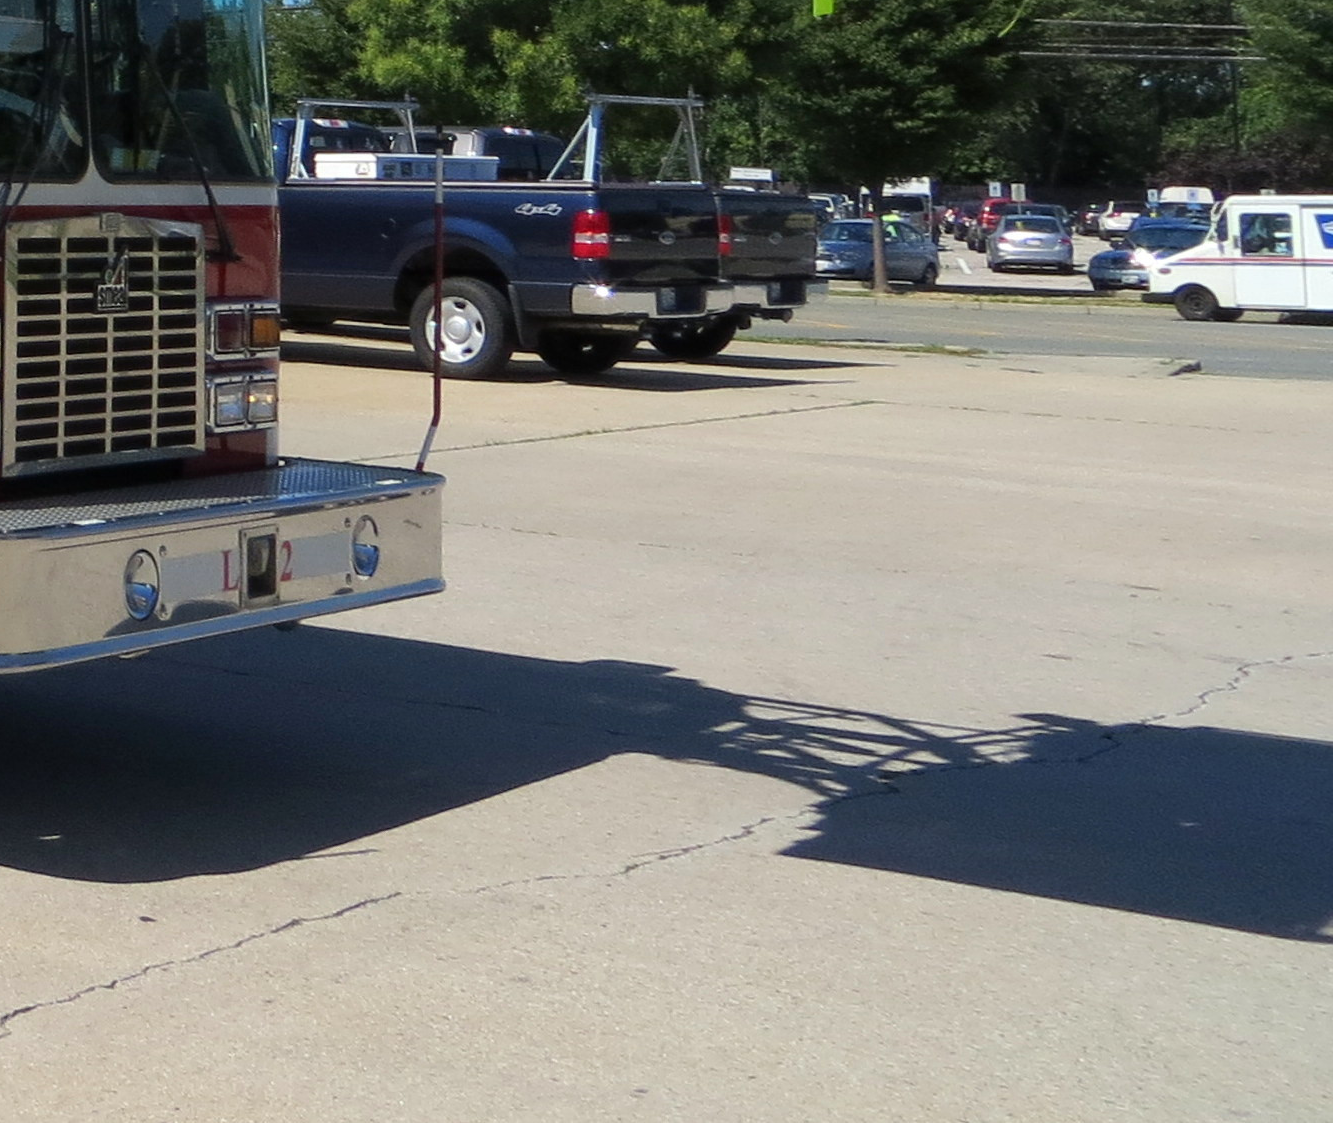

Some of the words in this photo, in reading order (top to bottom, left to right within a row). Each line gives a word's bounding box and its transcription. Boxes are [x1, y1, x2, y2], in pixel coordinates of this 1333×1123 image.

[514, 202, 563, 216] 4x4
[221, 549, 240, 592] L
[280, 540, 293, 582] 2
